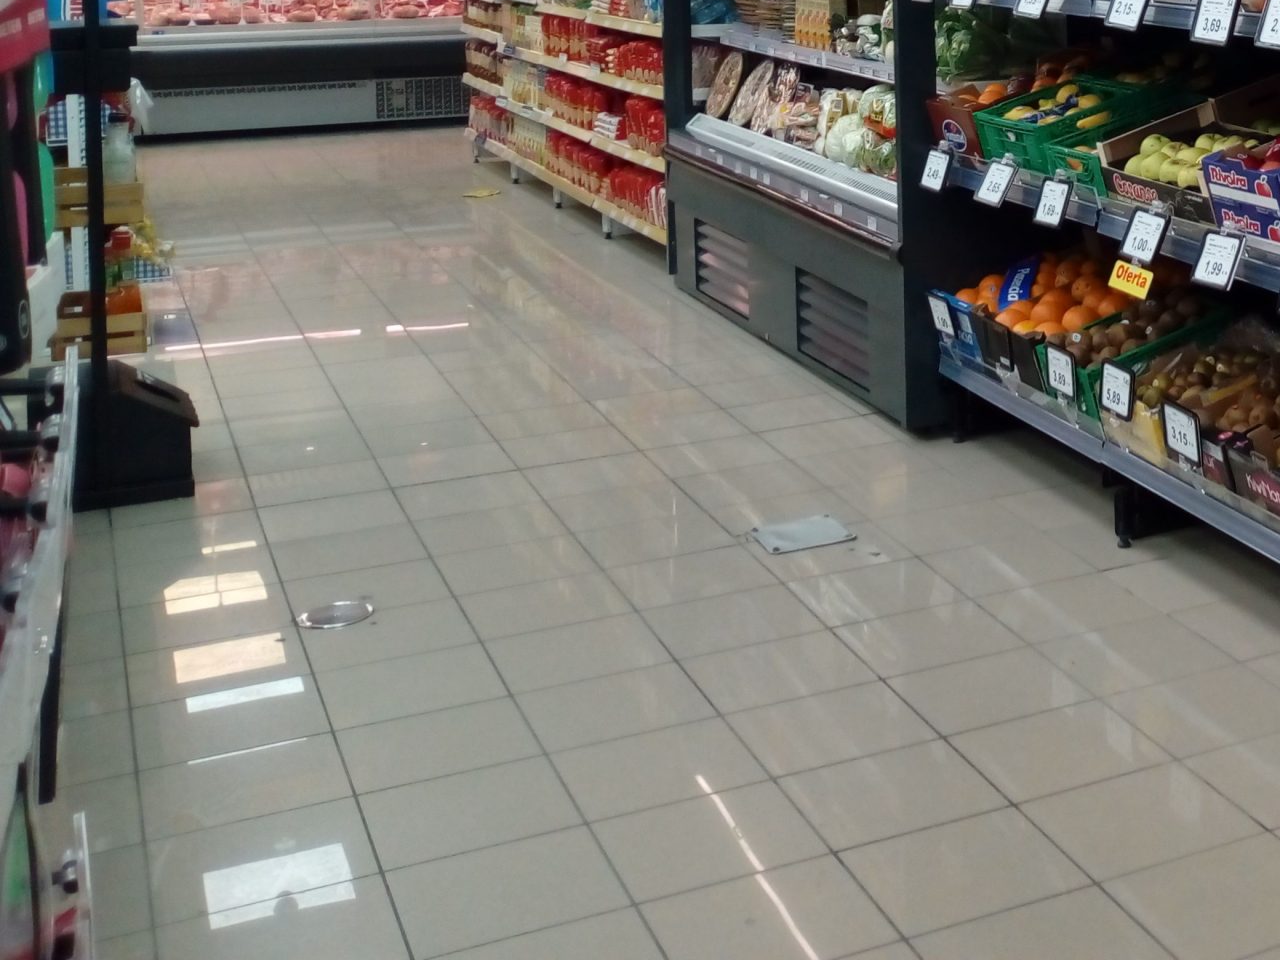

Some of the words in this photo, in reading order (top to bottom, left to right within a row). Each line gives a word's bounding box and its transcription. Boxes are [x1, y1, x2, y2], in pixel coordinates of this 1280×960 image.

[1115, 1, 1132, 17] 2,15
[1202, 17, 1221, 34] 3,69
[1209, 167, 1248, 189] Rivoira
[1131, 236, 1147, 252] 1,00
[1204, 260, 1223, 276] 1,99
[1115, 265, 1147, 289] Oferta
[1053, 370, 1066, 386] 3,89
[1106, 389, 1121, 405] 5,89
[1171, 426, 1188, 446] 3,15
